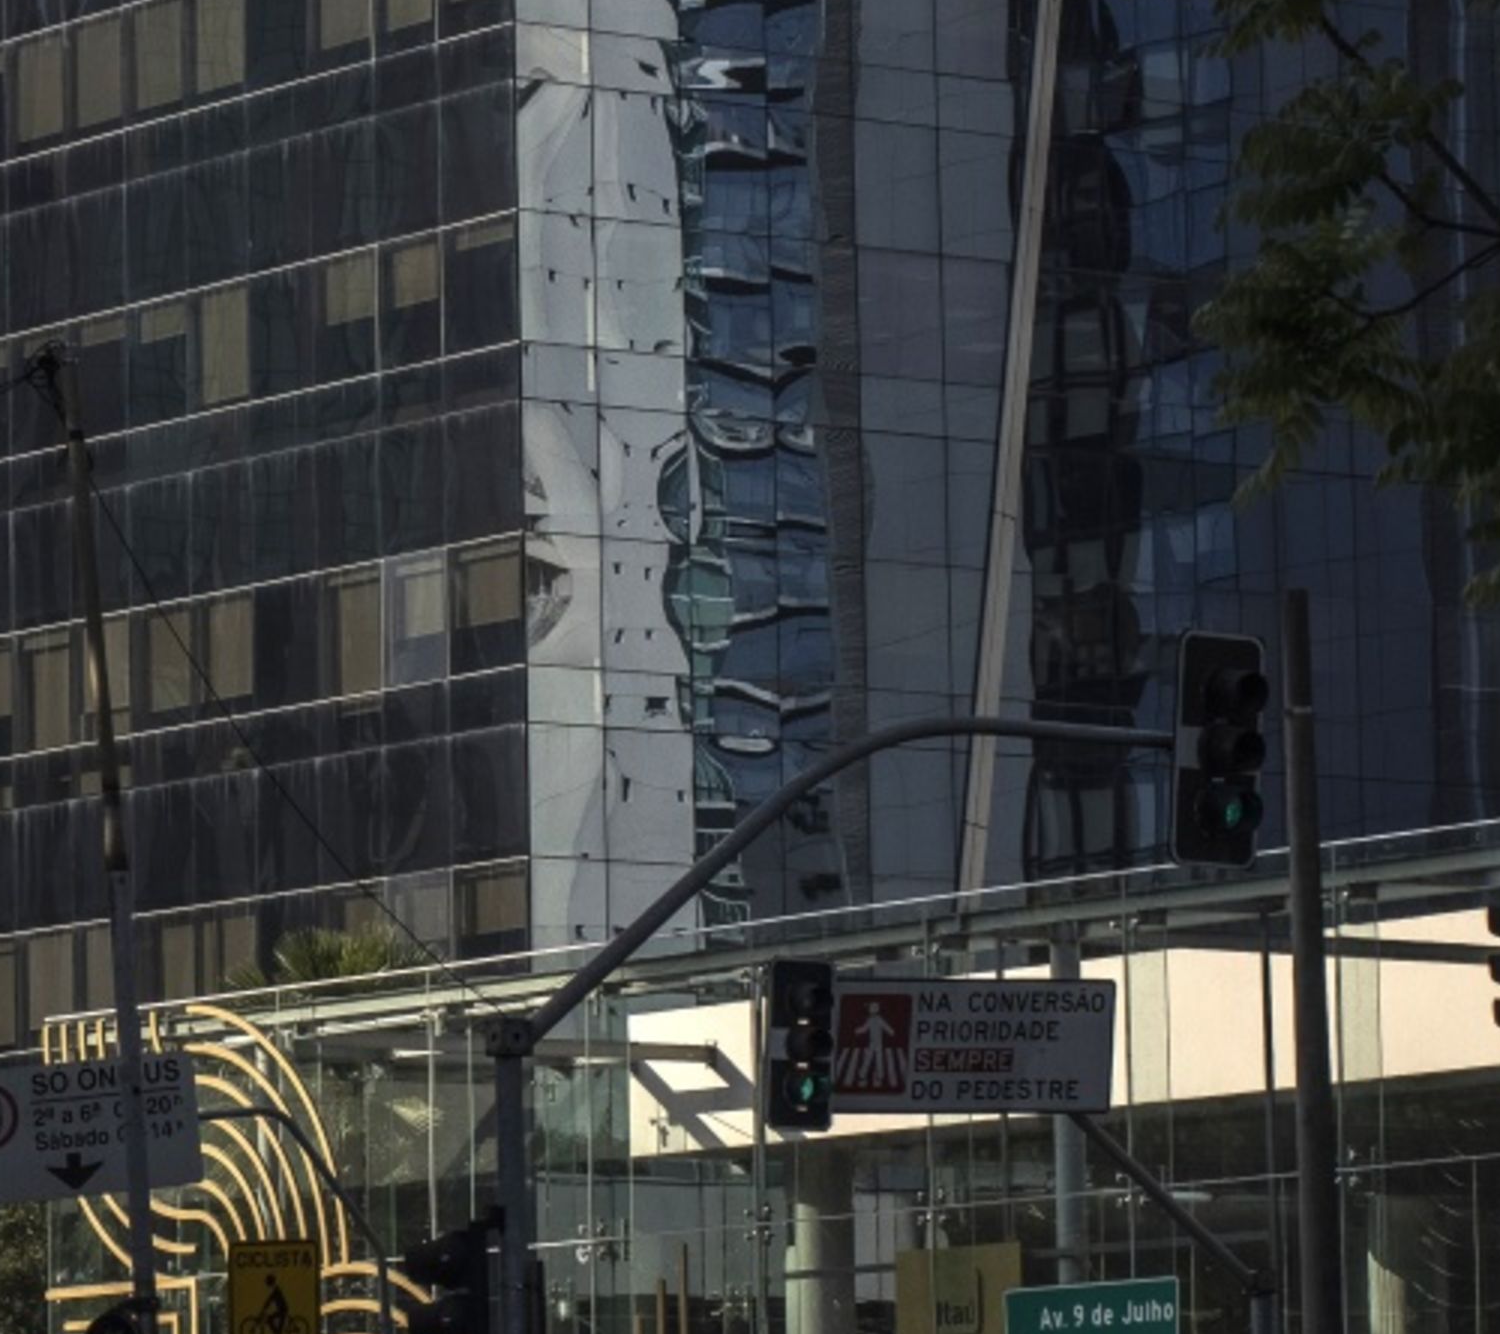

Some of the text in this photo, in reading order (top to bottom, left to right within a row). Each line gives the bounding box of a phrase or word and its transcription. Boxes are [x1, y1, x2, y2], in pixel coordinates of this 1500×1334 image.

[917, 987, 1106, 1014] NA CONVERSÃO
[916, 1020, 1061, 1042] PRIORIDADE
[916, 1049, 1014, 1071] SEMPRE
[31, 1059, 181, 1095] SÓ ÔNUS
[911, 1079, 1080, 1101] DO PEDESTRE
[61, 1109, 73, 1124] a
[35, 1128, 110, 1151] Sábado
[236, 1250, 313, 1268] CICLISTA
[1039, 1299, 1175, 1332] Av. 9 de Julho
